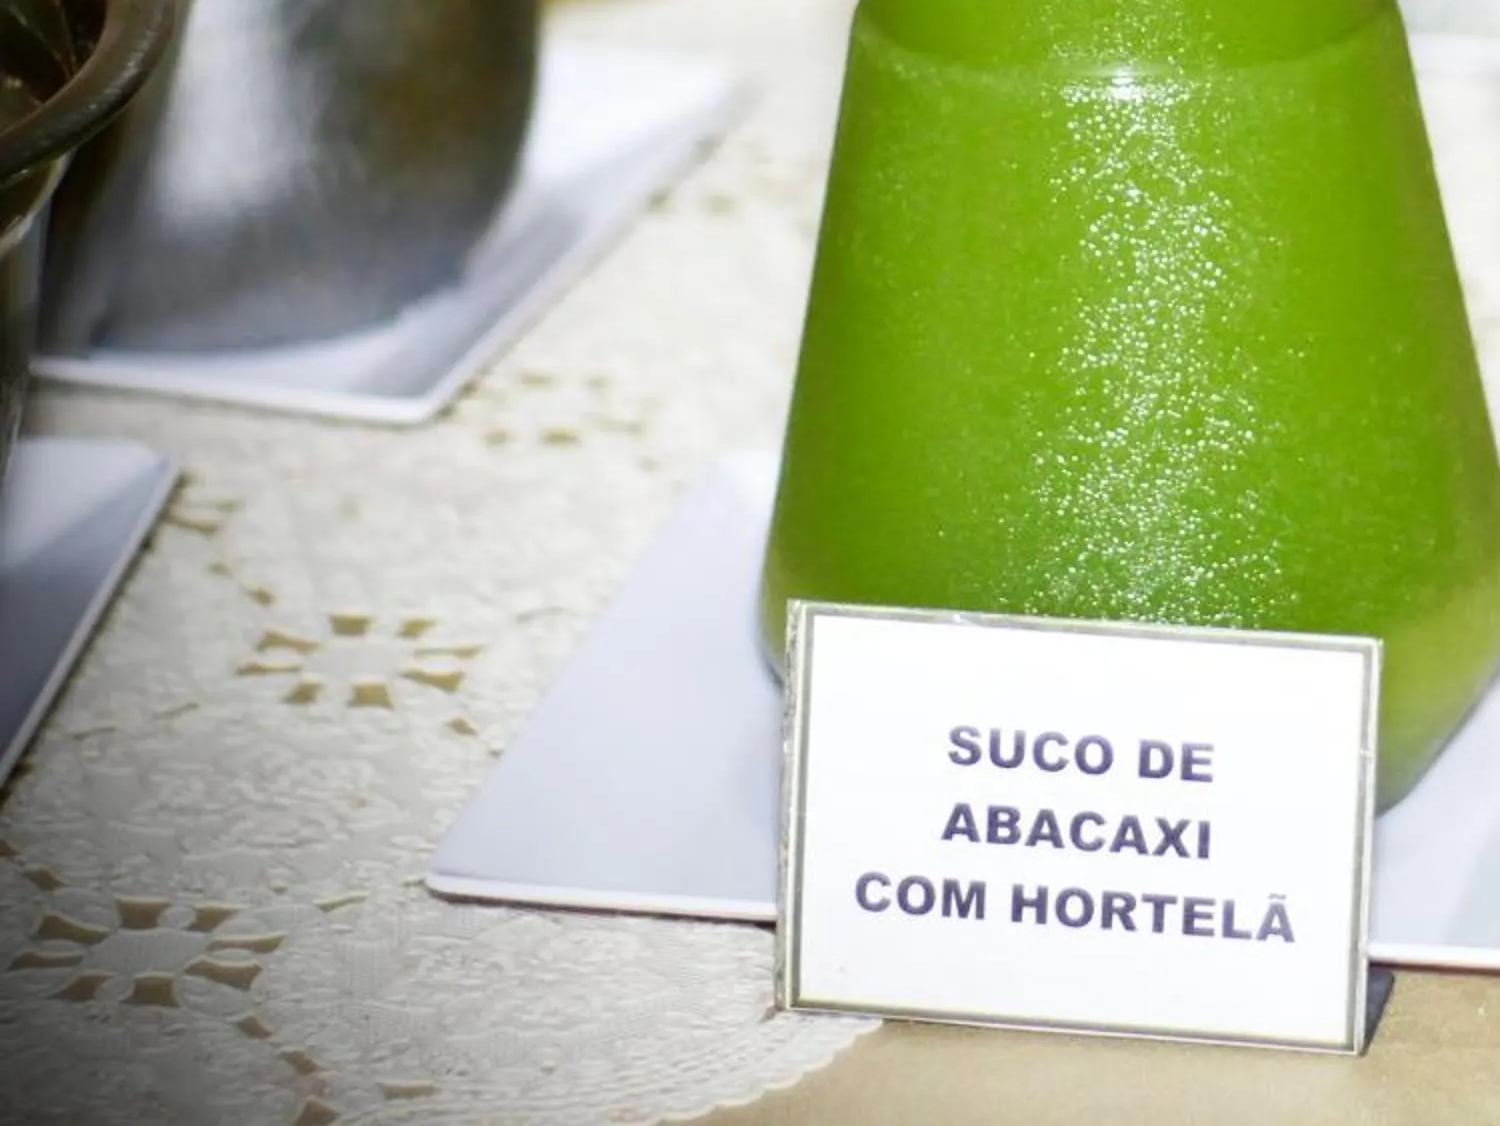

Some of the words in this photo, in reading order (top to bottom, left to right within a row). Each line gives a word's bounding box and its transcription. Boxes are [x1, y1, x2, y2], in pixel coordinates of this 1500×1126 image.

[947, 726, 1114, 777] SUCO
[1137, 740, 1213, 783] DE
[941, 802, 1211, 860] ABACAXI
[854, 871, 986, 920] COM
[1010, 883, 1296, 943] HORTELÃ
